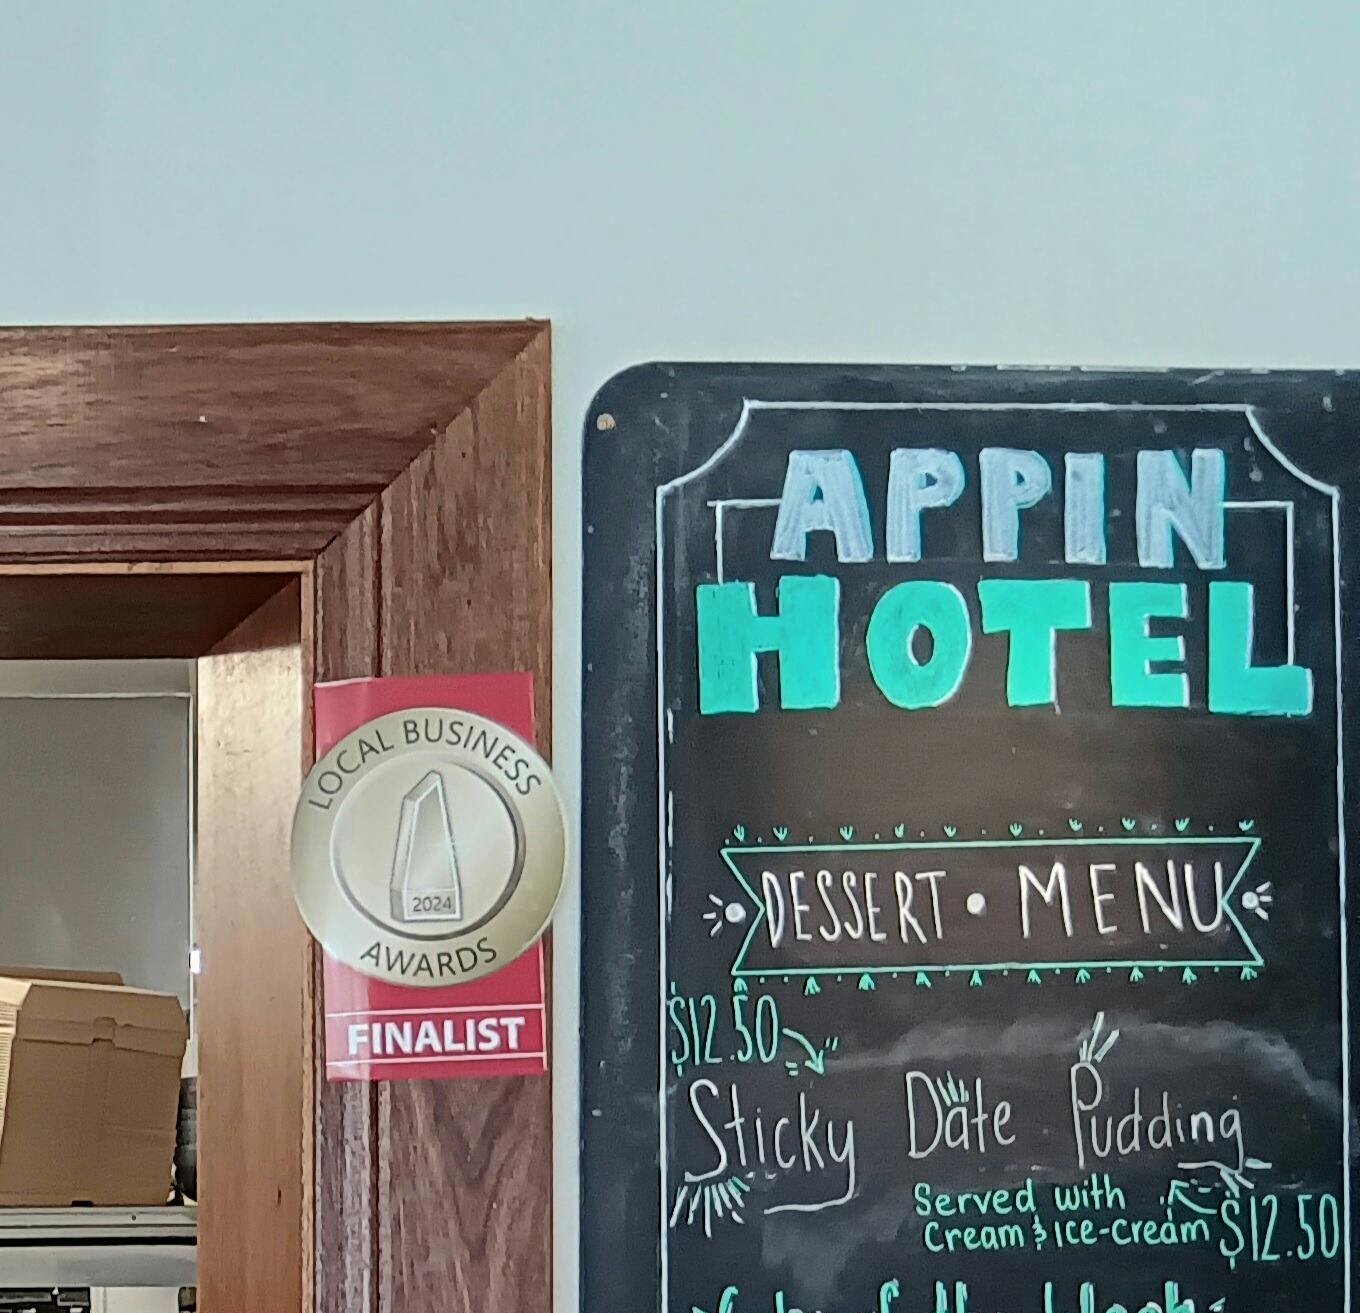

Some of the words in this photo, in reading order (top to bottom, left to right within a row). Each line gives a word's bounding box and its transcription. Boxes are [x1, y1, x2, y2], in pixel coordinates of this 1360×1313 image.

[770, 448, 1227, 568] APPIN
[696, 575, 1314, 716] HOTEL
[308, 729, 395, 810] LOCAL
[402, 718, 542, 796] BUSINESS
[412, 895, 453, 912] 2024
[761, 869, 947, 948] DESSERT
[1018, 861, 1225, 938] MENU
[359, 937, 498, 978] AWARDS
[347, 1016, 526, 1056] FINALIST
[669, 982, 778, 1077] $12.50
[684, 1078, 856, 1214] Sticky
[906, 1070, 1017, 1159] Date
[1070, 1060, 1247, 1175] Pudding
[914, 1178, 1036, 1218] Served
[1055, 1173, 1126, 1212] with
[924, 1219, 1025, 1253] Cream
[1218, 1192, 1341, 1270] $12.50
